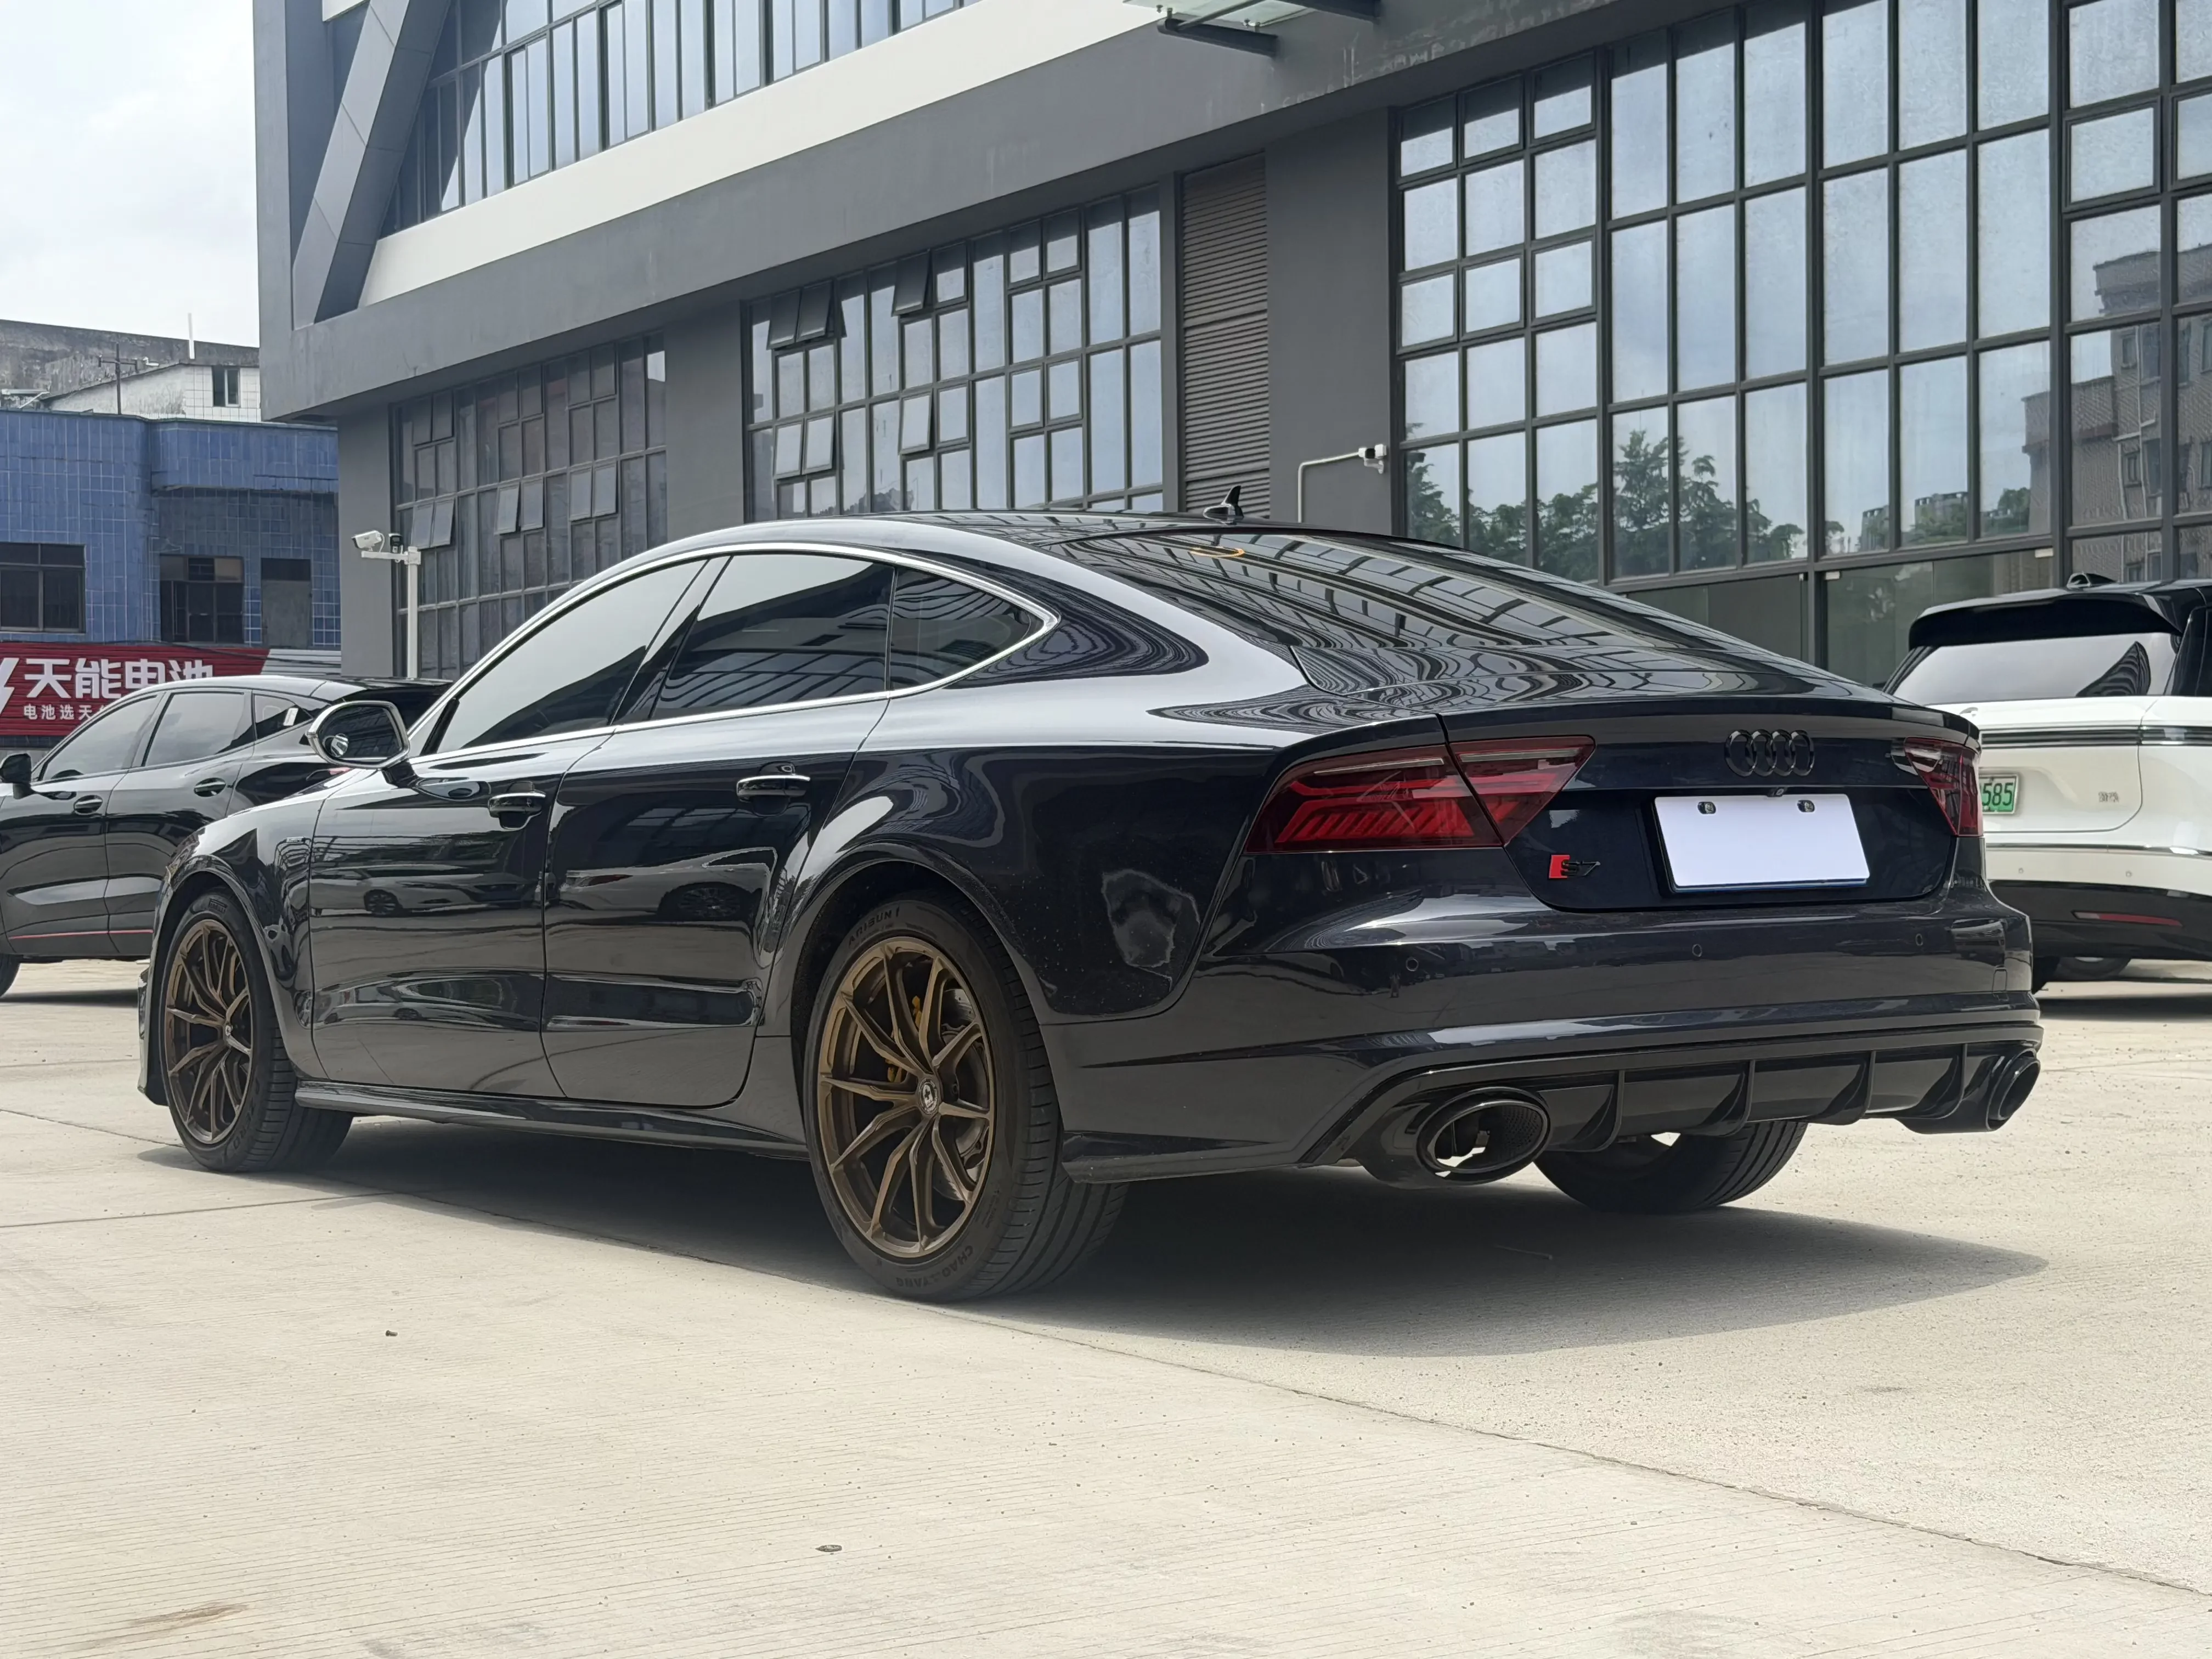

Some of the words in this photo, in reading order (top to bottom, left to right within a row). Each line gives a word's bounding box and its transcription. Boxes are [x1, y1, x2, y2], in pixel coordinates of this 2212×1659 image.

[24, 704, 109, 720] 电池选天
[1980, 782, 2013, 806] 585
